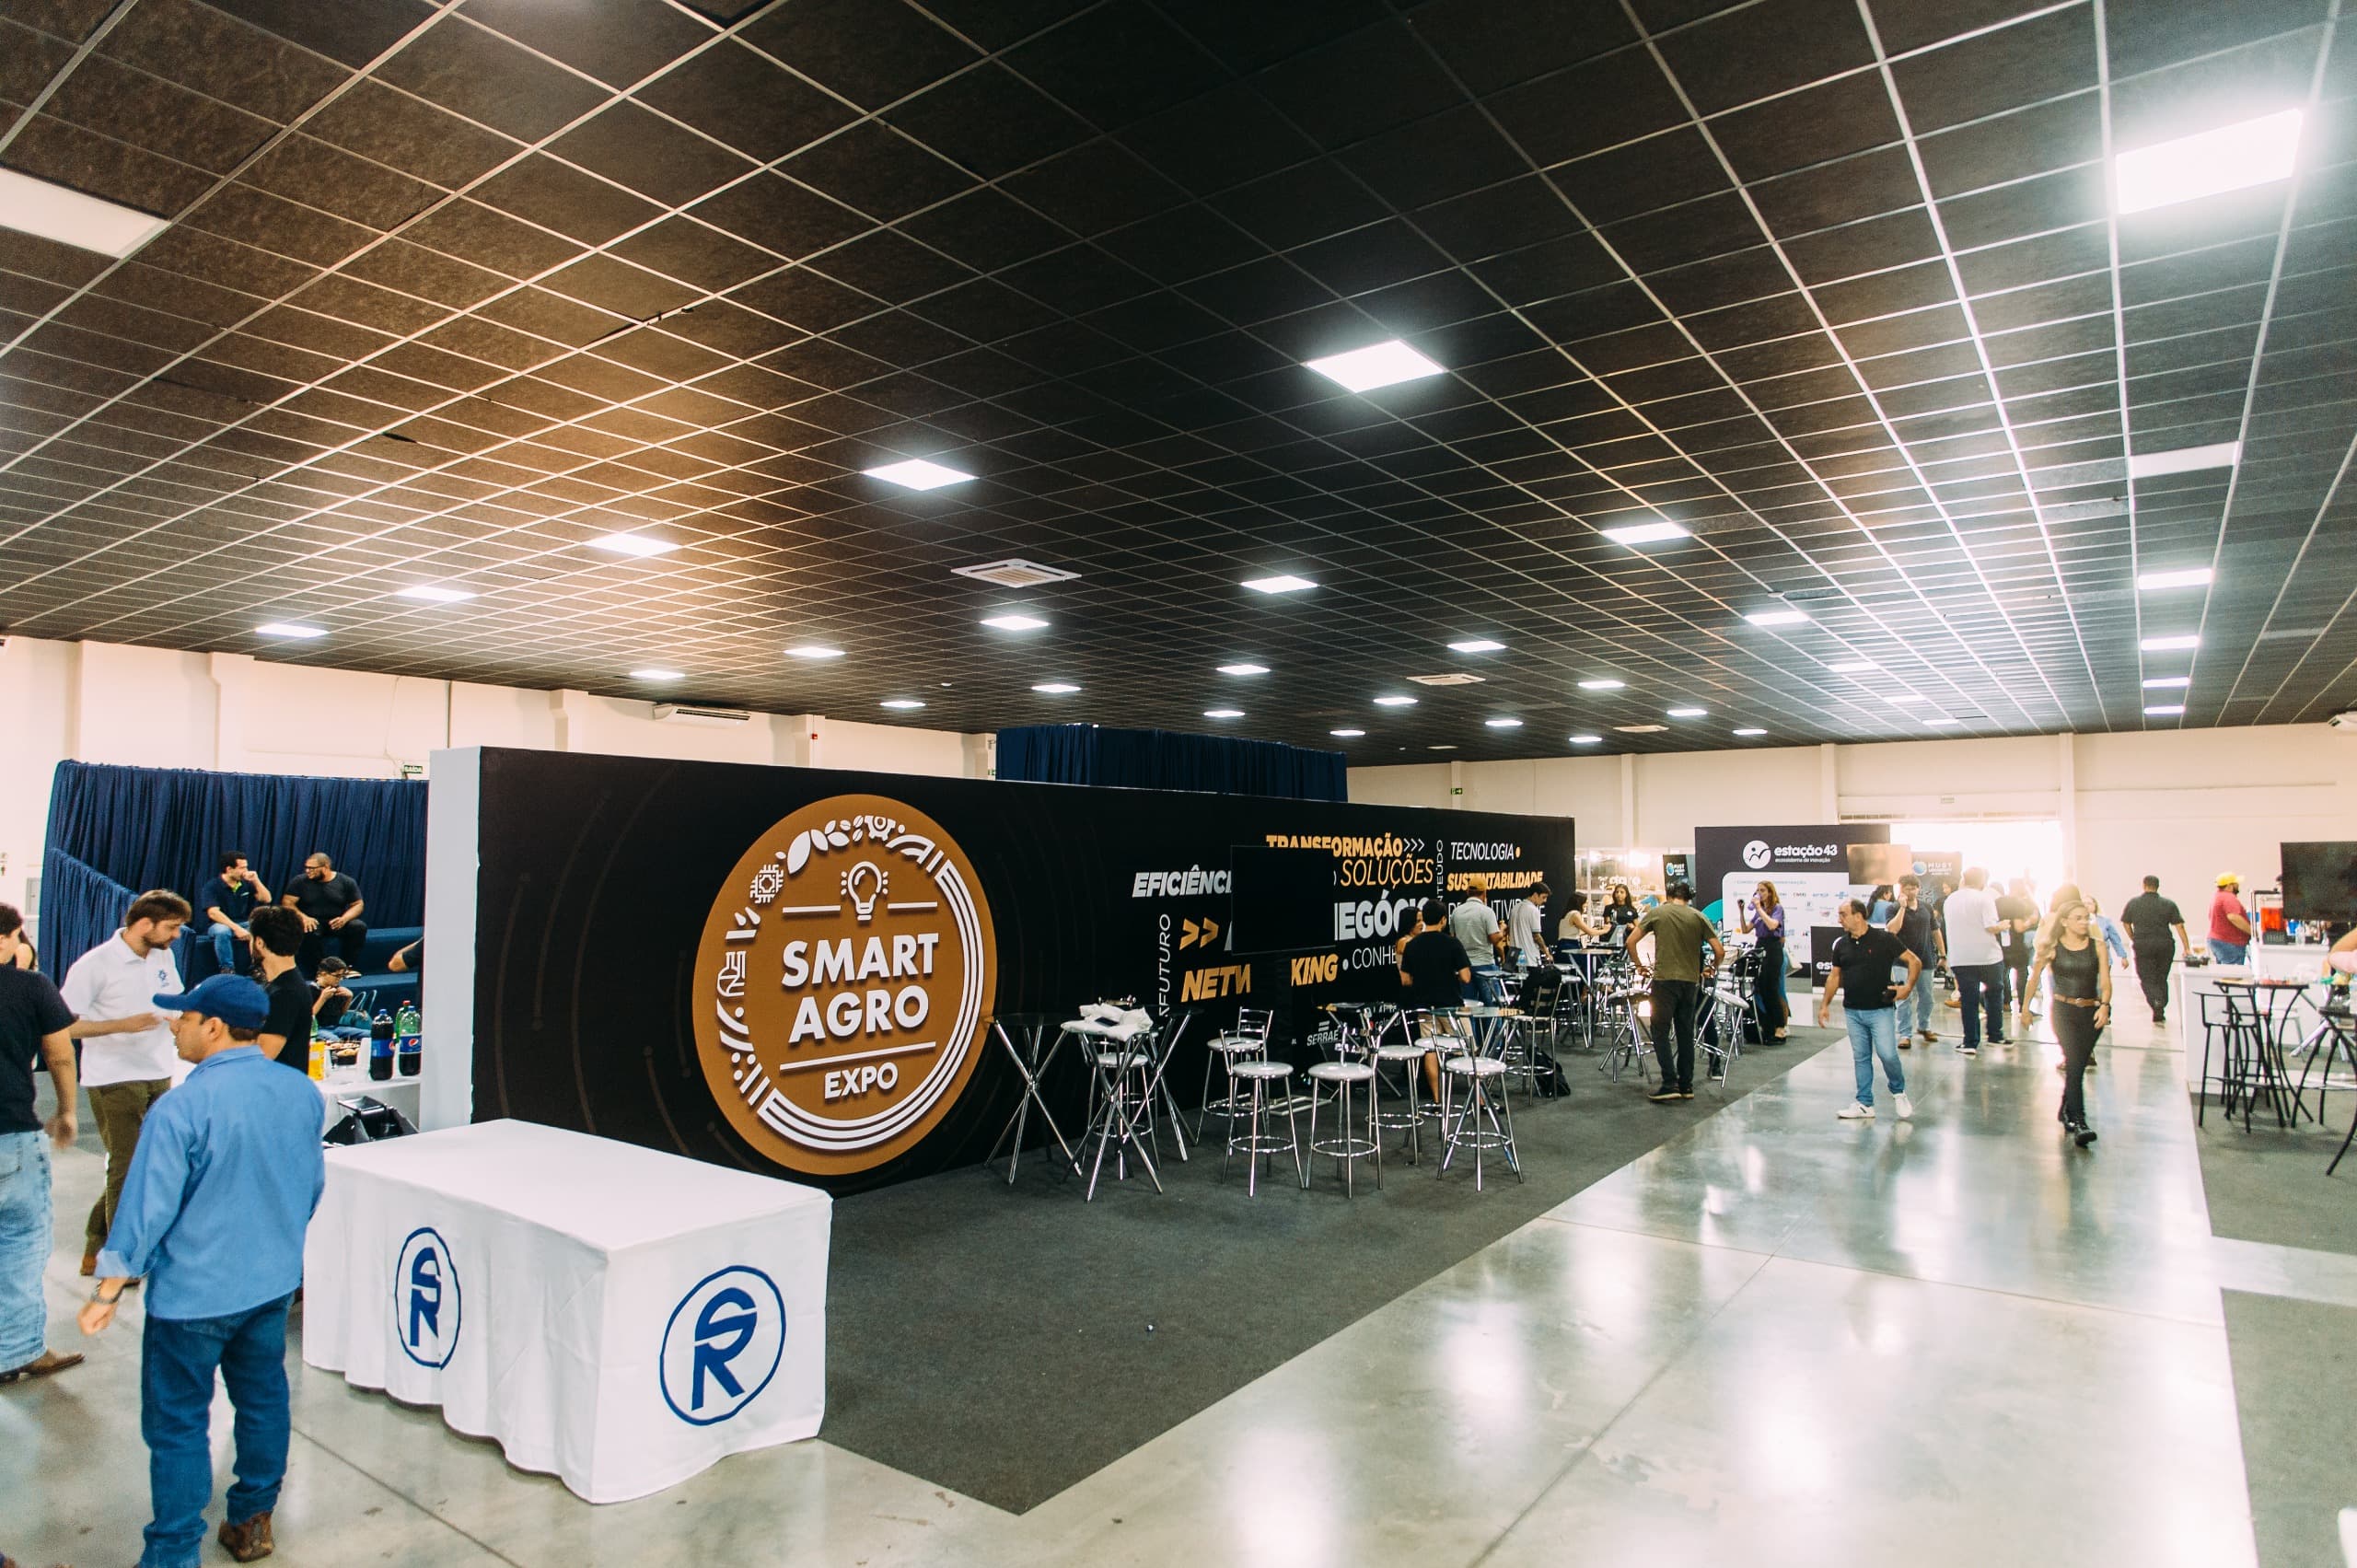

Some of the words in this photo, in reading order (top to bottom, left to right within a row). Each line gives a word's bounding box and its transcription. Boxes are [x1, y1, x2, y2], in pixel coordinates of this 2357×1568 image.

[1450, 842, 1515, 861] TECNOLOGIA
[1132, 864, 1232, 898] EFICIÊNCI
[1340, 852, 1434, 890] SOLUÇÕES
[782, 933, 939, 987] SMART
[1352, 945, 1397, 970] CONHE
[788, 985, 929, 1043] AGRO
[824, 1062, 899, 1099] EXPO
